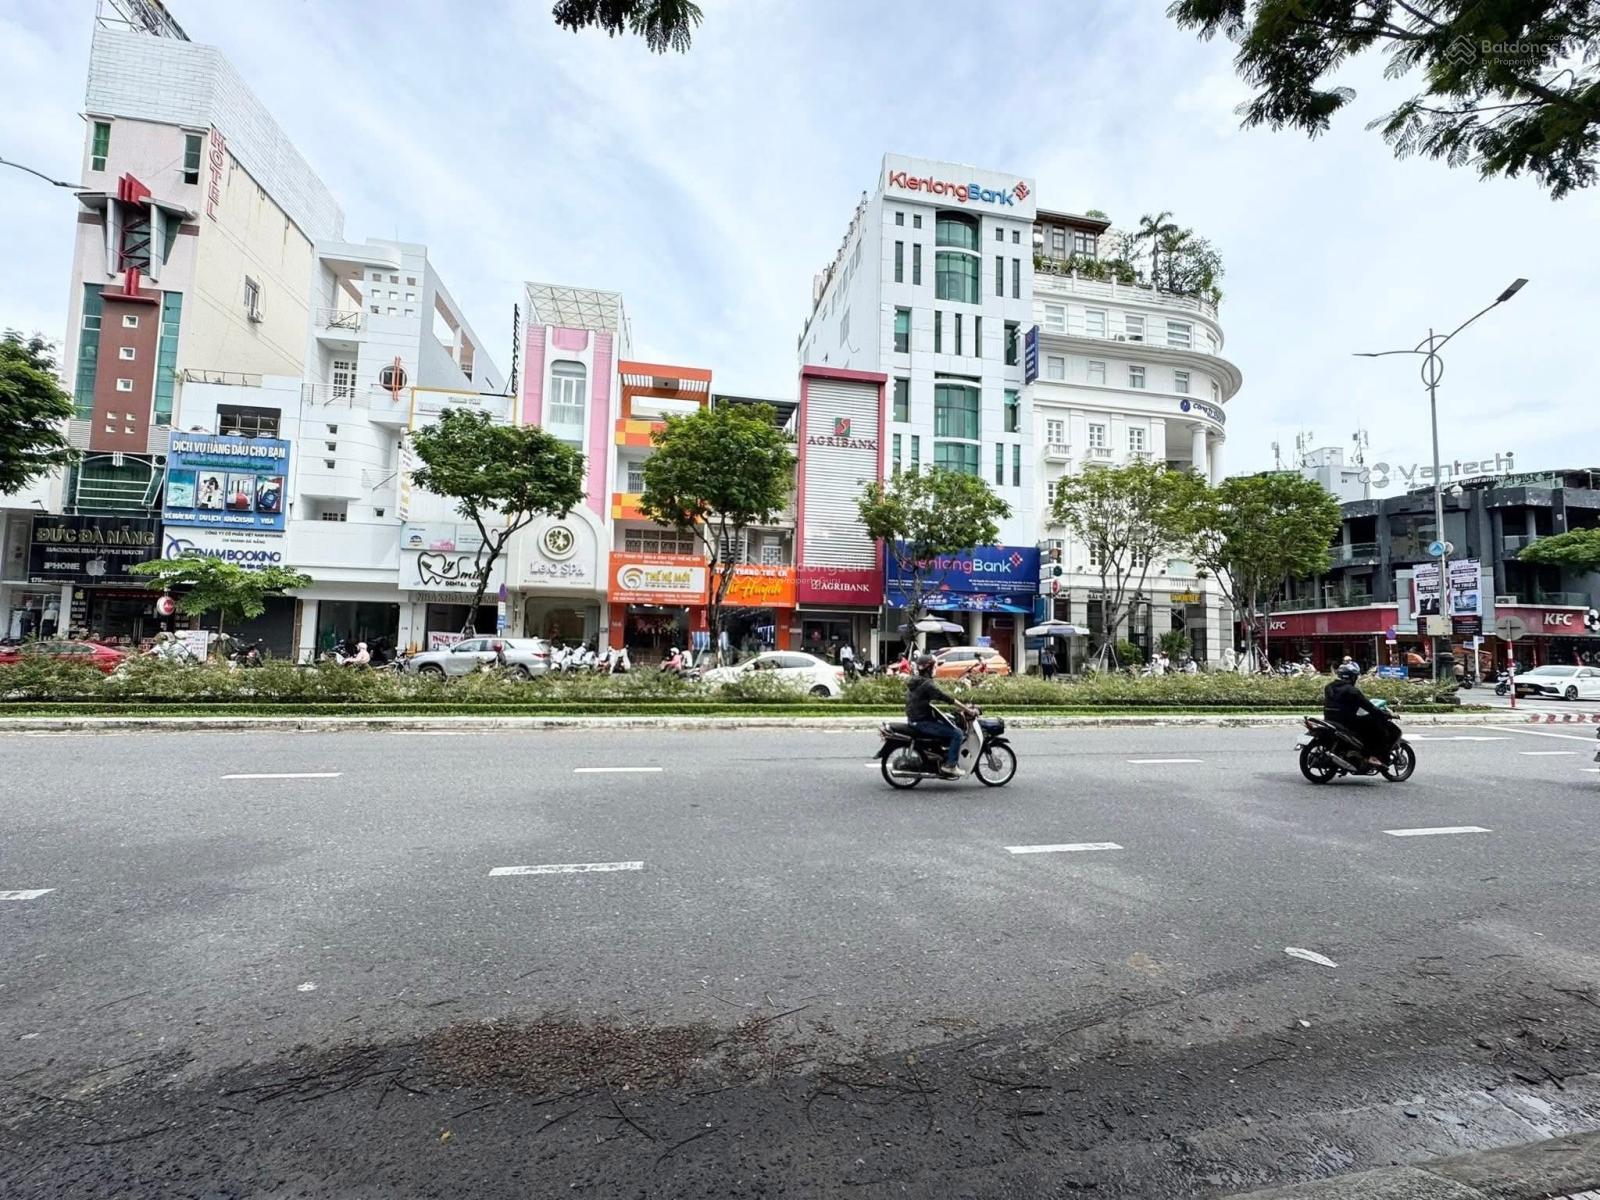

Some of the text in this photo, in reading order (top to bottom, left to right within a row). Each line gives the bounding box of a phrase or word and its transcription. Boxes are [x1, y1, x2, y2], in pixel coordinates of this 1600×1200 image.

[206, 128, 224, 222] HOTEL
[172, 440, 193, 454] DỊCH
[194, 442, 206, 455] VỤ
[250, 446, 267, 457] CHO
[267, 447, 286, 460] BẠN
[807, 436, 877, 450] AGRIBANK
[78, 525, 104, 543] ĐÀ
[821, 583, 870, 593] AGRIBANK
[1269, 621, 1286, 630] KFC
[1543, 613, 1574, 626] KFC
